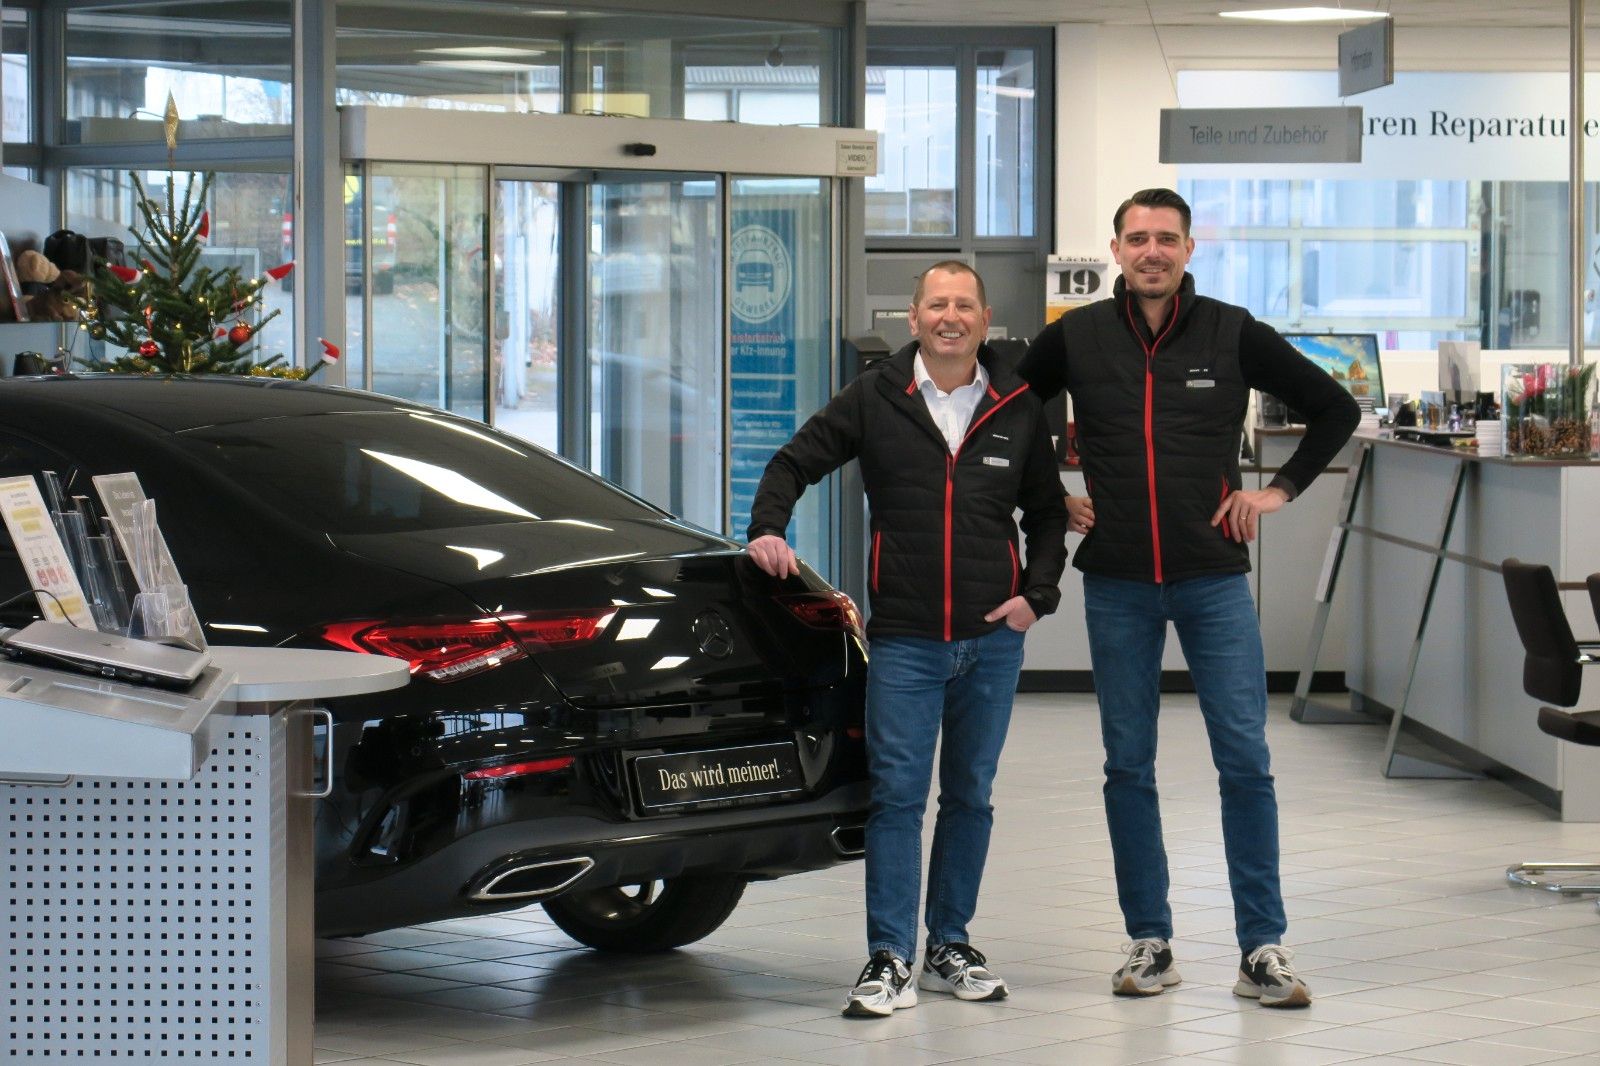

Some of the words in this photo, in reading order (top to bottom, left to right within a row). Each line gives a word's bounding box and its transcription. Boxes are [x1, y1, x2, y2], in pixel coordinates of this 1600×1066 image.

[1189, 125, 1223, 145] Teile
[1228, 126, 1257, 145] und
[1262, 124, 1329, 145] Zubehör
[1361, 115, 1418, 137] ren
[1428, 110, 1599, 144] Reparatue
[1053, 269, 1101, 295] 19
[658, 768, 688, 791] Das
[690, 763, 726, 786] wird
[727, 758, 781, 784] meiner!
